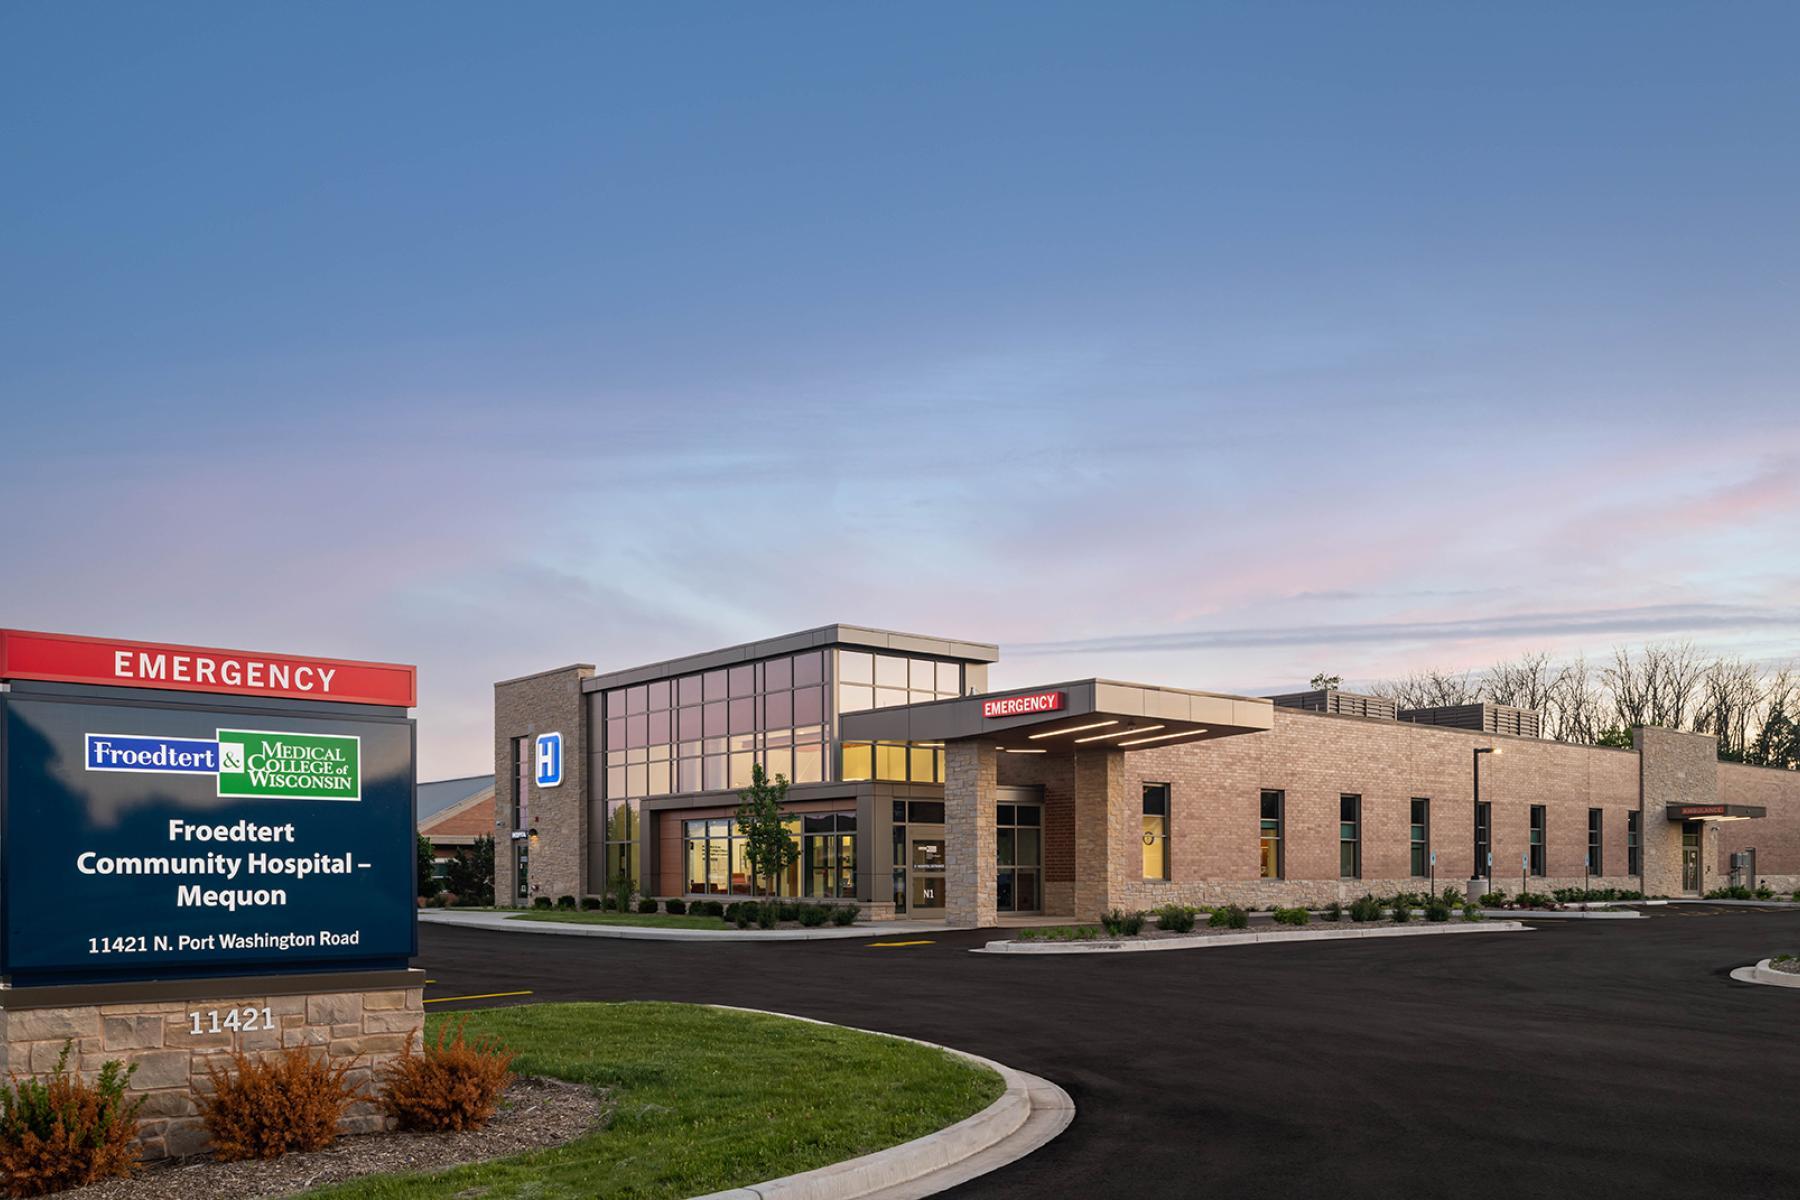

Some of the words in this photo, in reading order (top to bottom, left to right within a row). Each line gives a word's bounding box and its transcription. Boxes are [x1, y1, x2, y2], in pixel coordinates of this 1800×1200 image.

[114, 650, 337, 692] EMERGENCY
[984, 694, 1056, 716] EMERGENCY
[93, 741, 215, 768] Froedtert
[222, 752, 241, 769] &
[261, 741, 346, 762] MEDICAL
[247, 753, 333, 775] COLLEGE
[336, 764, 349, 775] of
[249, 770, 352, 790] WISCONSIN
[169, 819, 296, 842] Froedtert
[76, 851, 242, 880] Community
[248, 852, 352, 879] Hospital
[176, 885, 287, 911] Mequon
[923, 889, 935, 899] N1
[88, 936, 148, 954] 11421
[154, 935, 173, 951] N.
[178, 934, 215, 951] Port
[218, 932, 316, 950] Washington
[319, 930, 360, 946] Road
[189, 1007, 275, 1035] 11421
